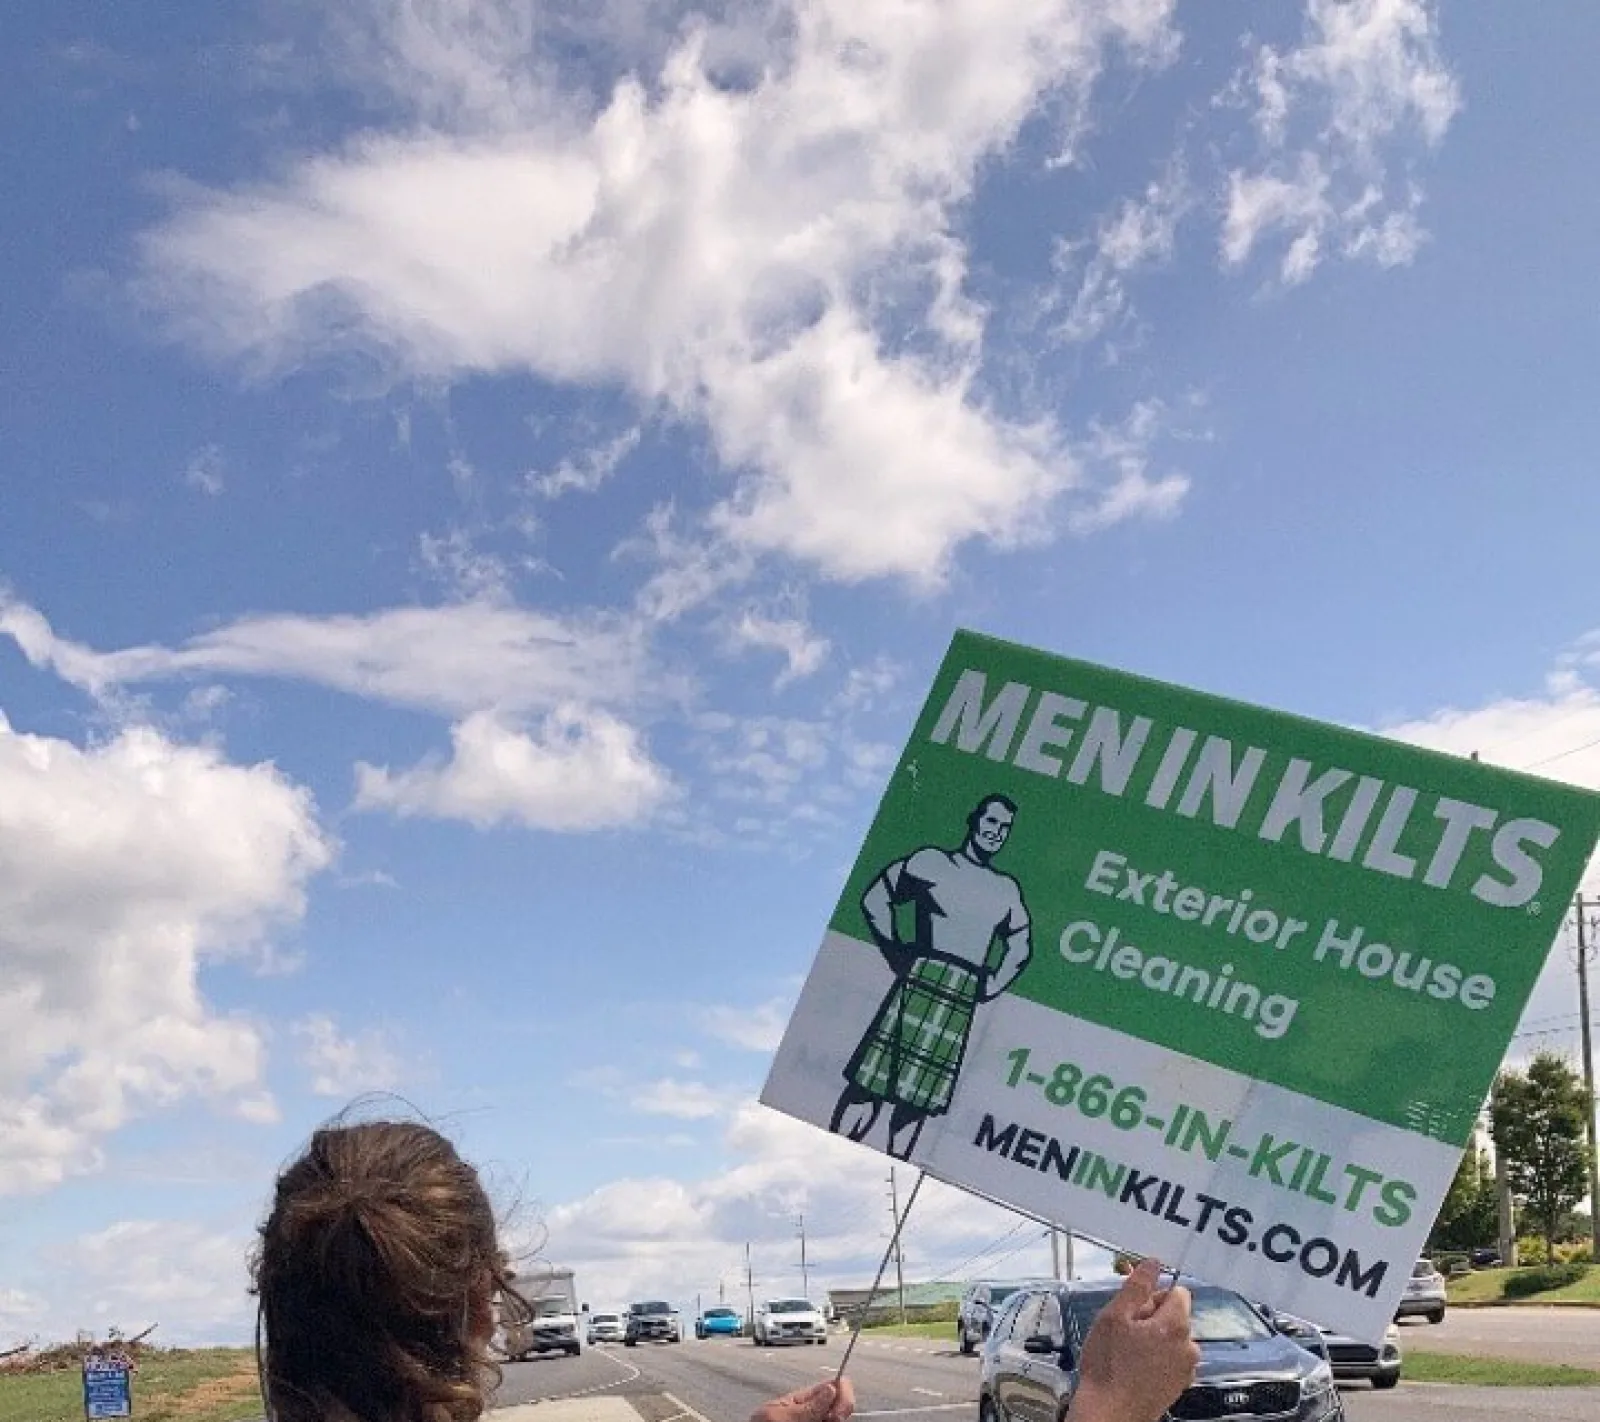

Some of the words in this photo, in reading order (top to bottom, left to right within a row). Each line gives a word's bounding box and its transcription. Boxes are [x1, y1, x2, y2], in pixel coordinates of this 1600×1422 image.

[930, 668, 1153, 796] MEN
[1144, 726, 1268, 830] IN
[1258, 757, 1561, 908] KILTS
[1059, 920, 1300, 1039] Cleaning
[1084, 850, 1308, 950] Exterior
[1312, 918, 1497, 1010] House
[972, 1113, 1389, 1299] MENINKILTS.COM
[1006, 1048, 1418, 1228] 1-866-IN-KILTS
